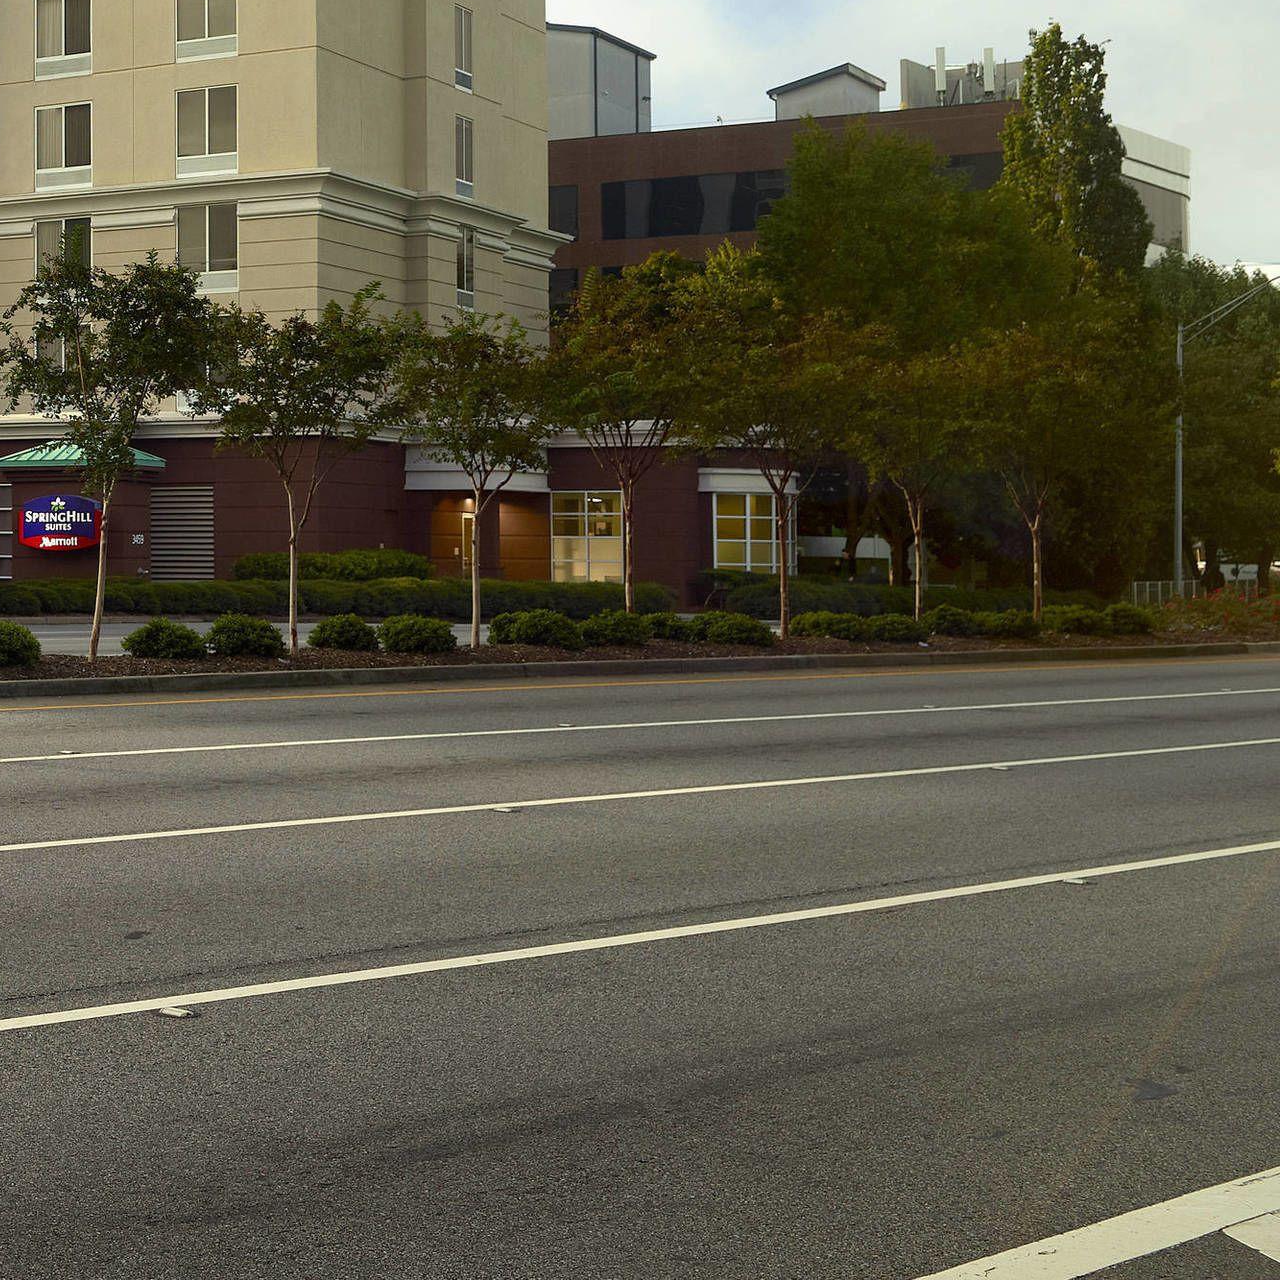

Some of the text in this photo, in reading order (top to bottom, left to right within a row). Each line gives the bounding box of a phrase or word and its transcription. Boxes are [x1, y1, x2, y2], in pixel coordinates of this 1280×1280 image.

[25, 510, 93, 523] SPRINGHILL
[45, 523, 72, 531] SUITES
[39, 536, 78, 548] Marriott
